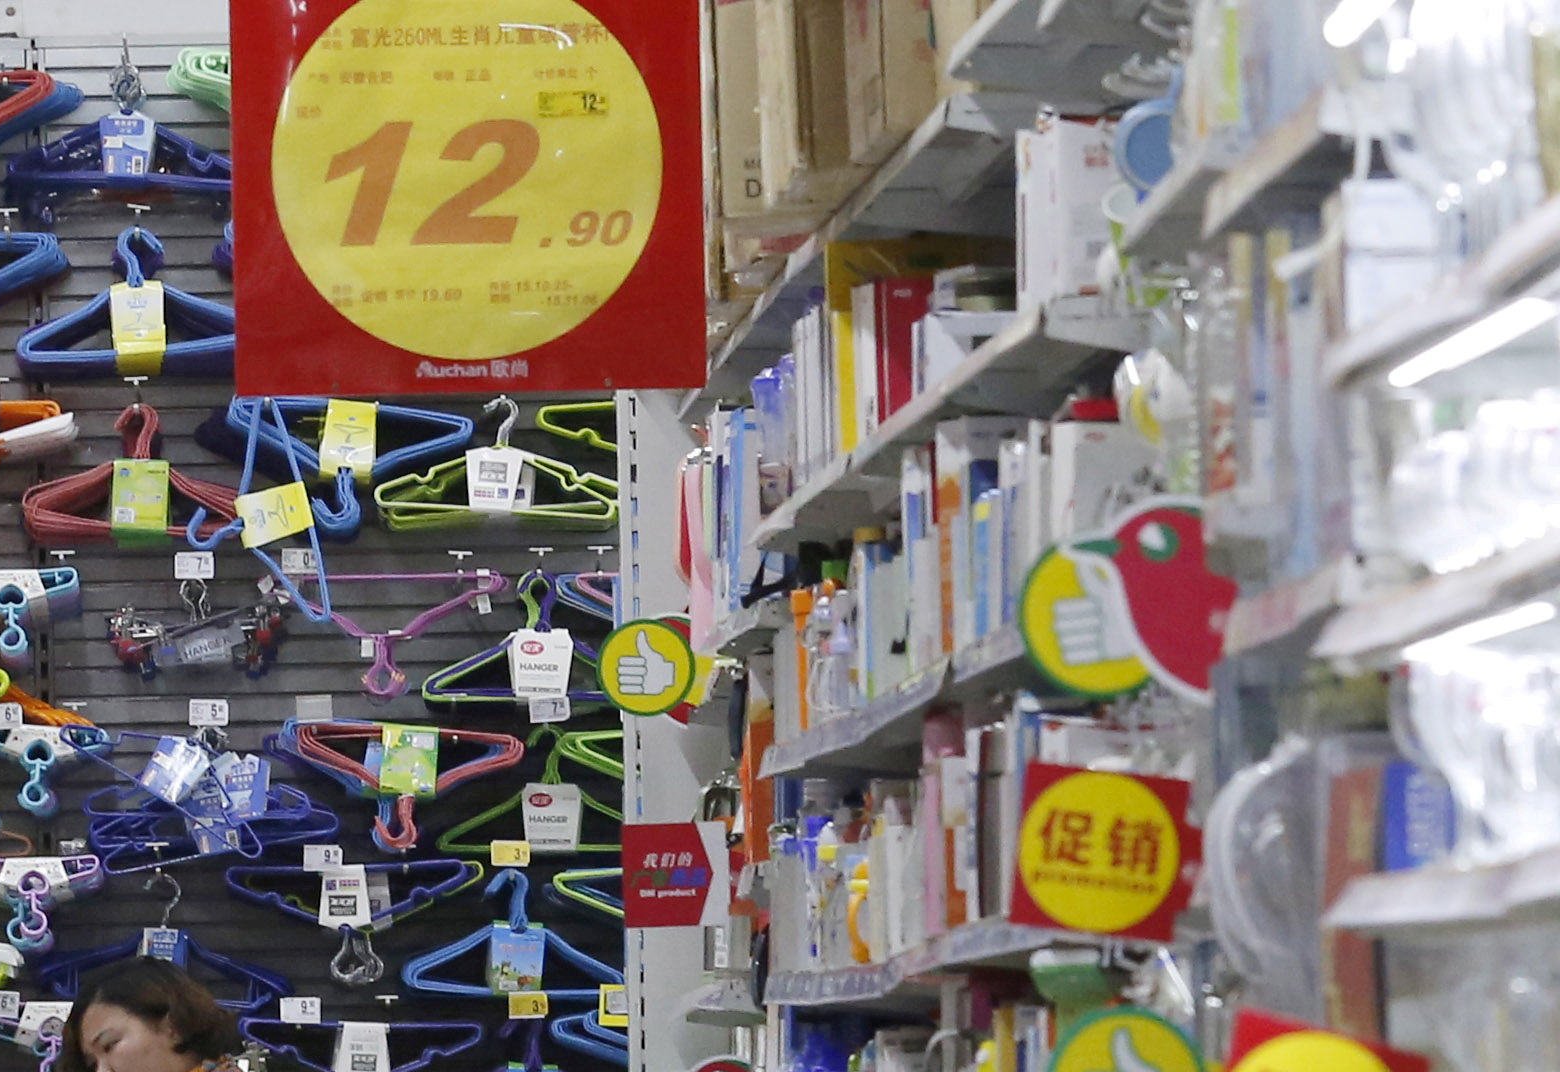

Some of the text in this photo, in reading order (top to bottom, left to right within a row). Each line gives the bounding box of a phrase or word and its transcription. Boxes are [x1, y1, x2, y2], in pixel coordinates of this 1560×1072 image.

[325, 118, 635, 247] 12.90
[417, 360, 488, 378] Auchan
[519, 662, 559, 674] HANGER
[528, 814, 568, 826] HANGER
[1039, 807, 1164, 877] 促销
